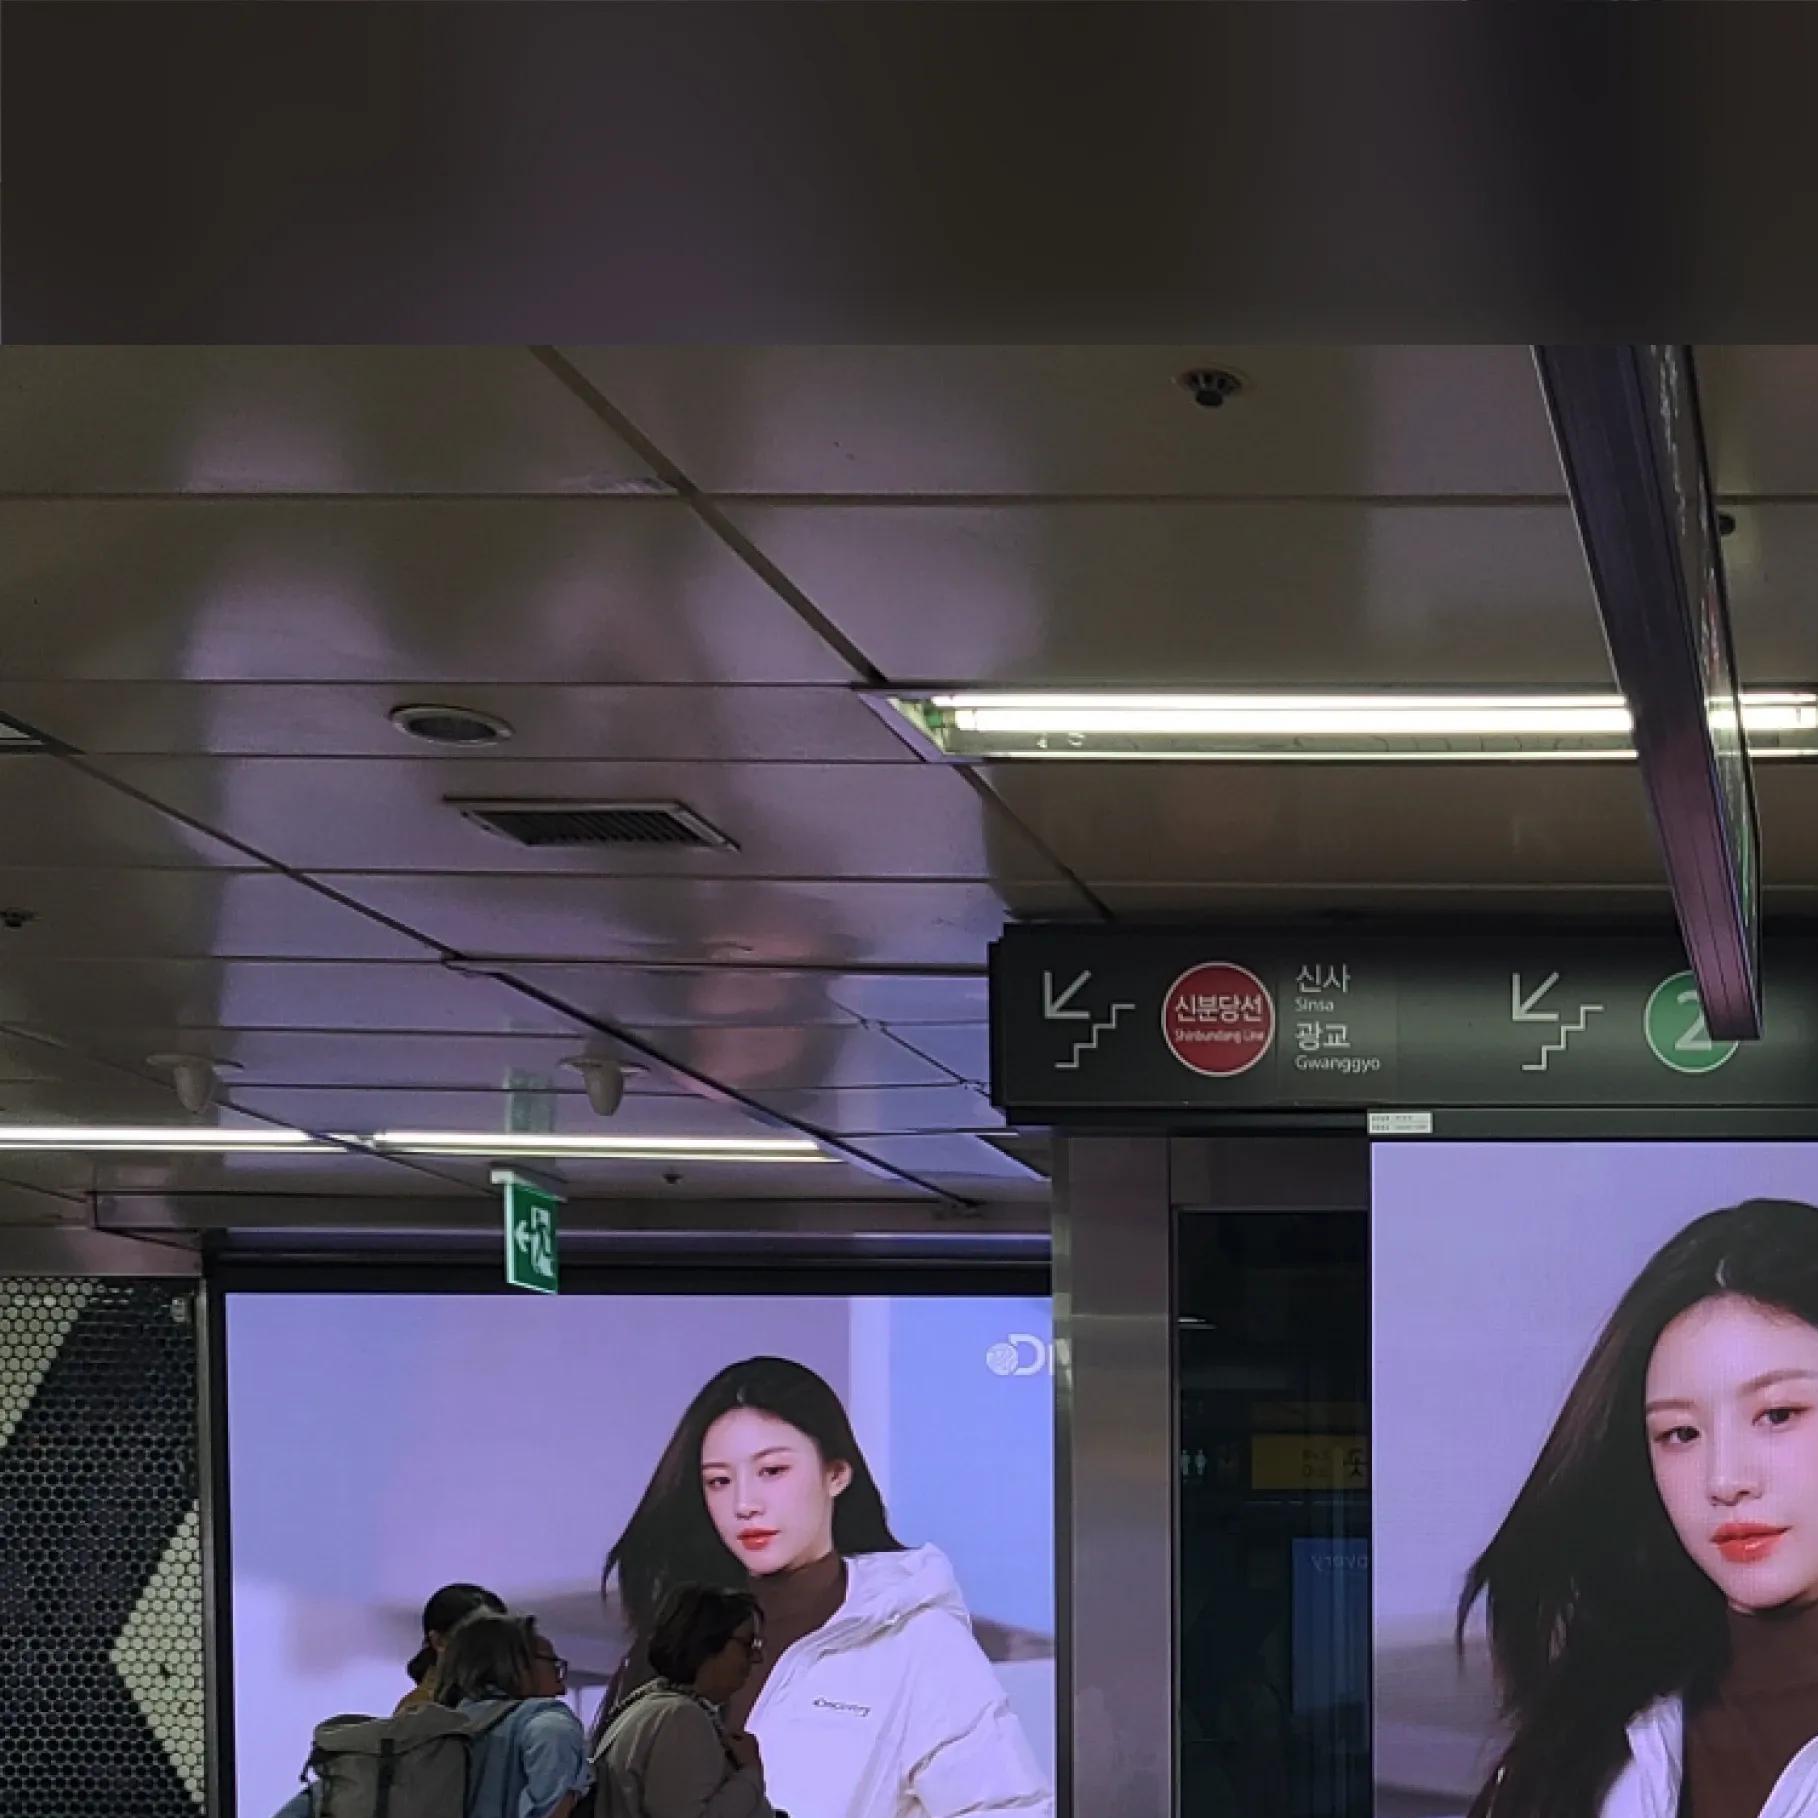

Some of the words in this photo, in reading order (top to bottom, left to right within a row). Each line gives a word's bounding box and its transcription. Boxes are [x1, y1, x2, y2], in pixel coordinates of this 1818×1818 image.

[1296, 963, 1351, 993] 신사
[1175, 993, 1263, 1023] 신분당선
[1294, 997, 1335, 1013] Sinsa
[1674, 990, 1713, 1051] 2
[1296, 1020, 1351, 1052] 광교
[1295, 1054, 1382, 1074] Gwanggyo
